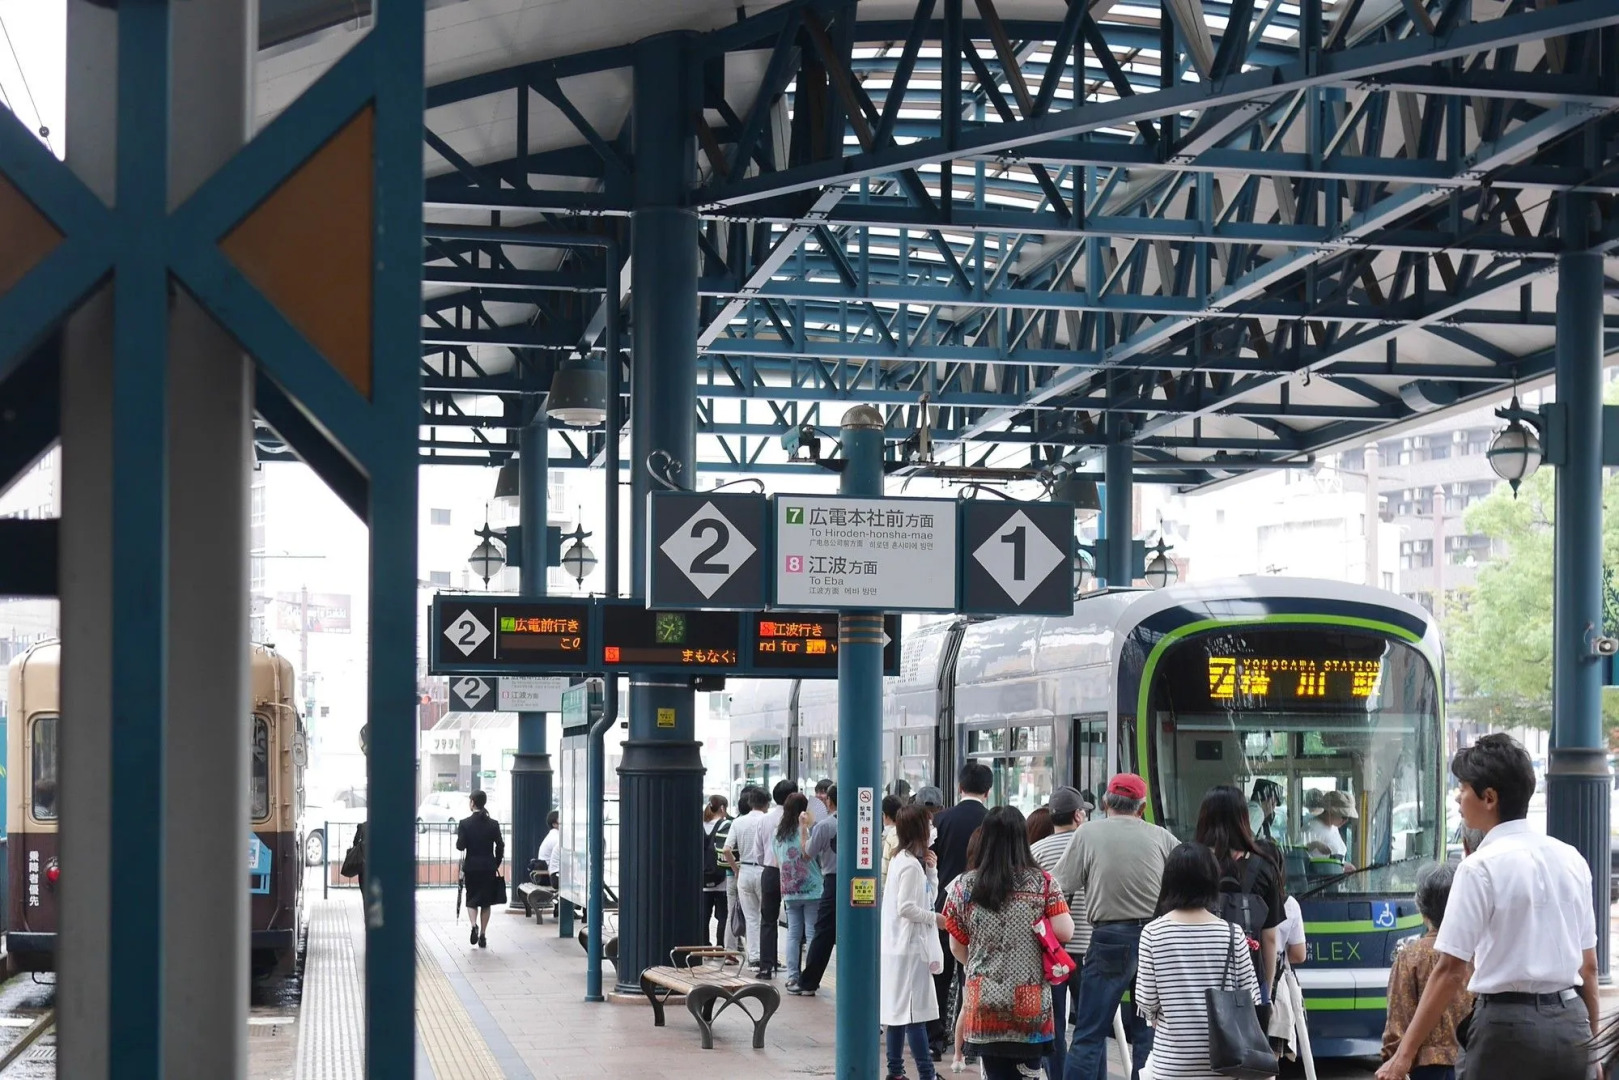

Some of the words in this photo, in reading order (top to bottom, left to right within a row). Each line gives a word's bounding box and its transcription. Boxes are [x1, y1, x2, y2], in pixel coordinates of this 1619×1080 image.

[789, 508, 801, 523] 7
[809, 507, 934, 529] 広電本社前方面
[810, 528, 822, 537] To
[825, 529, 934, 540] Hiroden-honsha-mae
[689, 518, 731, 575] 2
[1001, 525, 1026, 581] 1
[789, 557, 801, 571] 8
[808, 556, 878, 575] 江波方面
[809, 576, 821, 585] To
[824, 576, 844, 585] Eba
[458, 620, 476, 646] 2
[514, 618, 579, 633] 広電前行き
[773, 622, 823, 637] 江波行き
[780, 640, 800, 652] for
[1324, 660, 1381, 672] STATION
[1209, 659, 1236, 696] 7
[464, 677, 480, 699] 2
[861, 826, 869, 866] 終日禁煙
[1316, 941, 1361, 960] LEX
